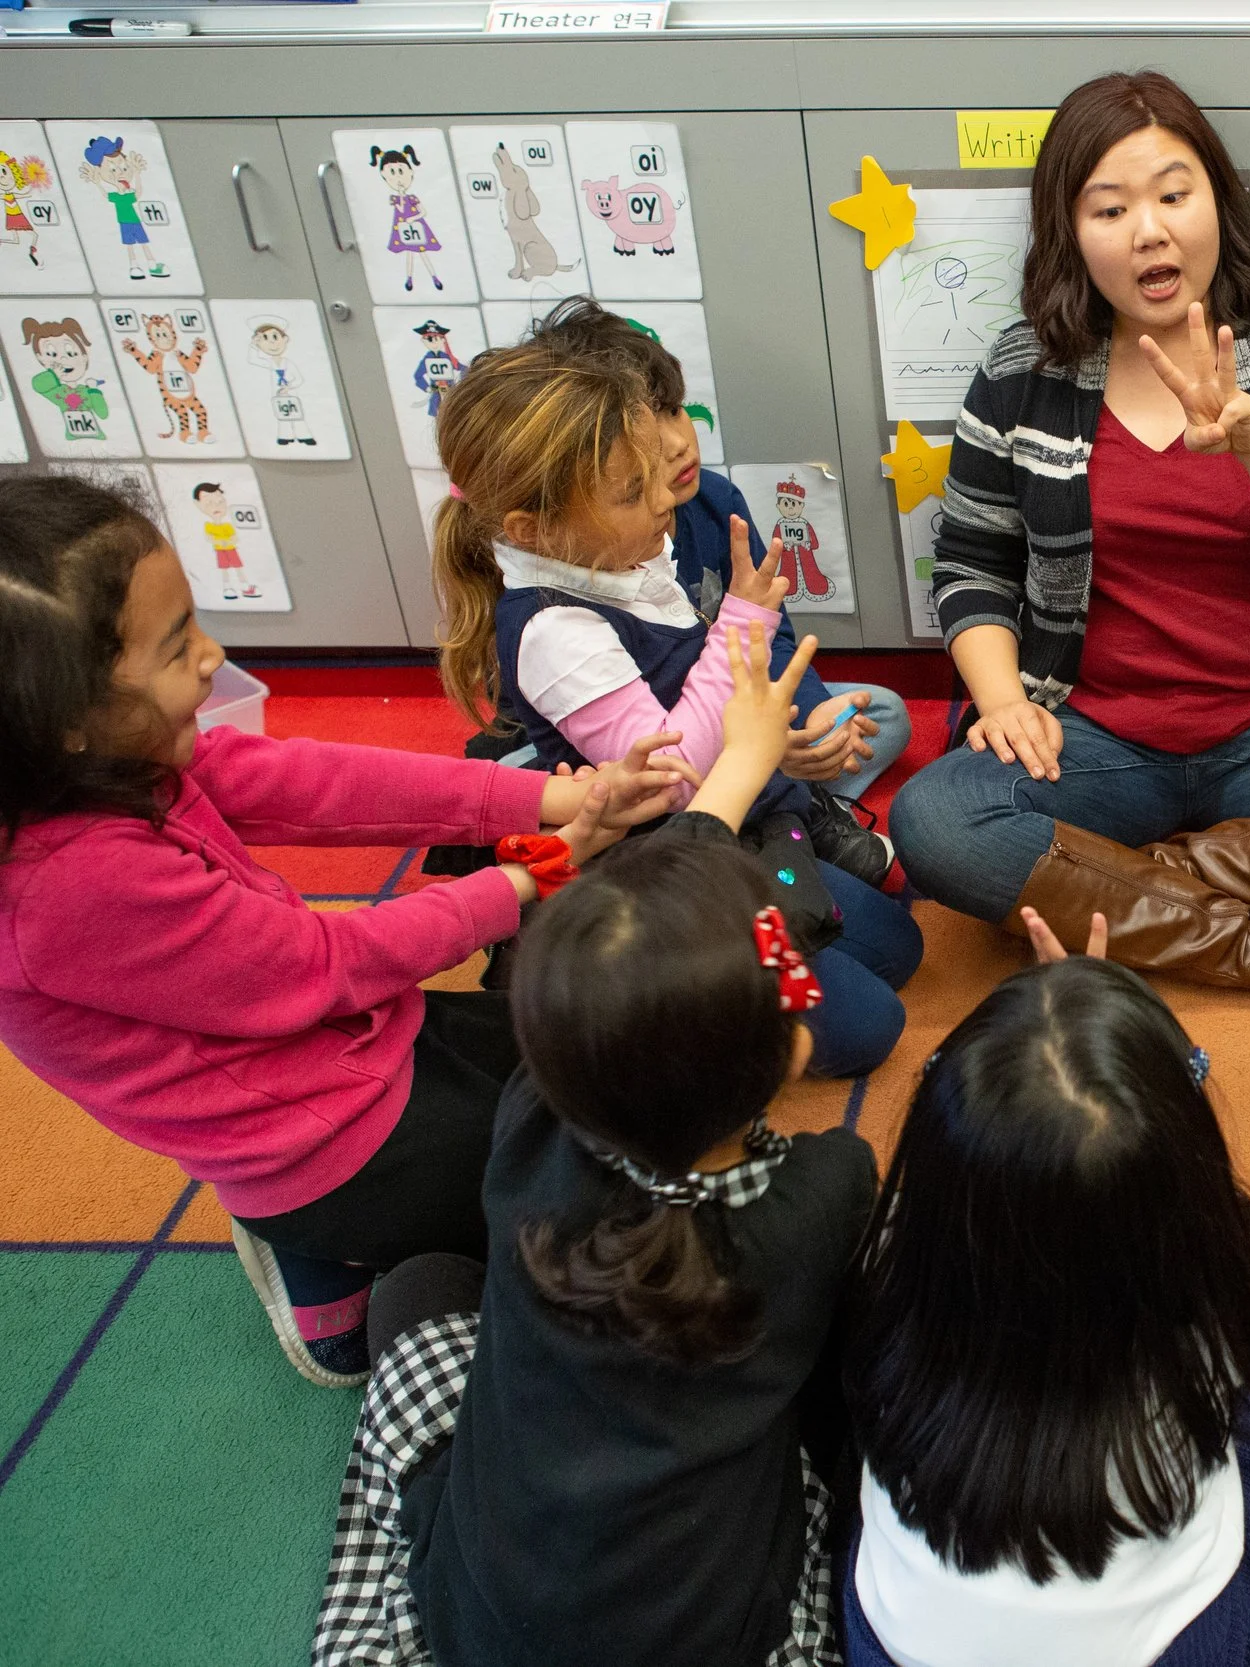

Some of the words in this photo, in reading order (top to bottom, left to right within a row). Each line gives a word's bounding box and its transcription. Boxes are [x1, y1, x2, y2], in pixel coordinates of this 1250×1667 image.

[499, 12, 600, 28] Theater
[613, 13, 652, 29] 연극
[964, 122, 1043, 158] Writi
[528, 147, 546, 160] ou
[638, 147, 658, 172] oi
[472, 180, 492, 192] ow
[32, 205, 52, 222] ay
[144, 204, 165, 222] th
[631, 197, 657, 222] oy
[402, 227, 421, 241] sh
[114, 313, 133, 327] er
[181, 313, 198, 327] ur
[429, 362, 449, 376] ar
[170, 373, 184, 388] ir
[277, 399, 298, 416] igh
[67, 415, 96, 433] ink
[906, 456, 929, 484] 3
[235, 510, 256, 523] oa
[784, 525, 804, 540] ing
